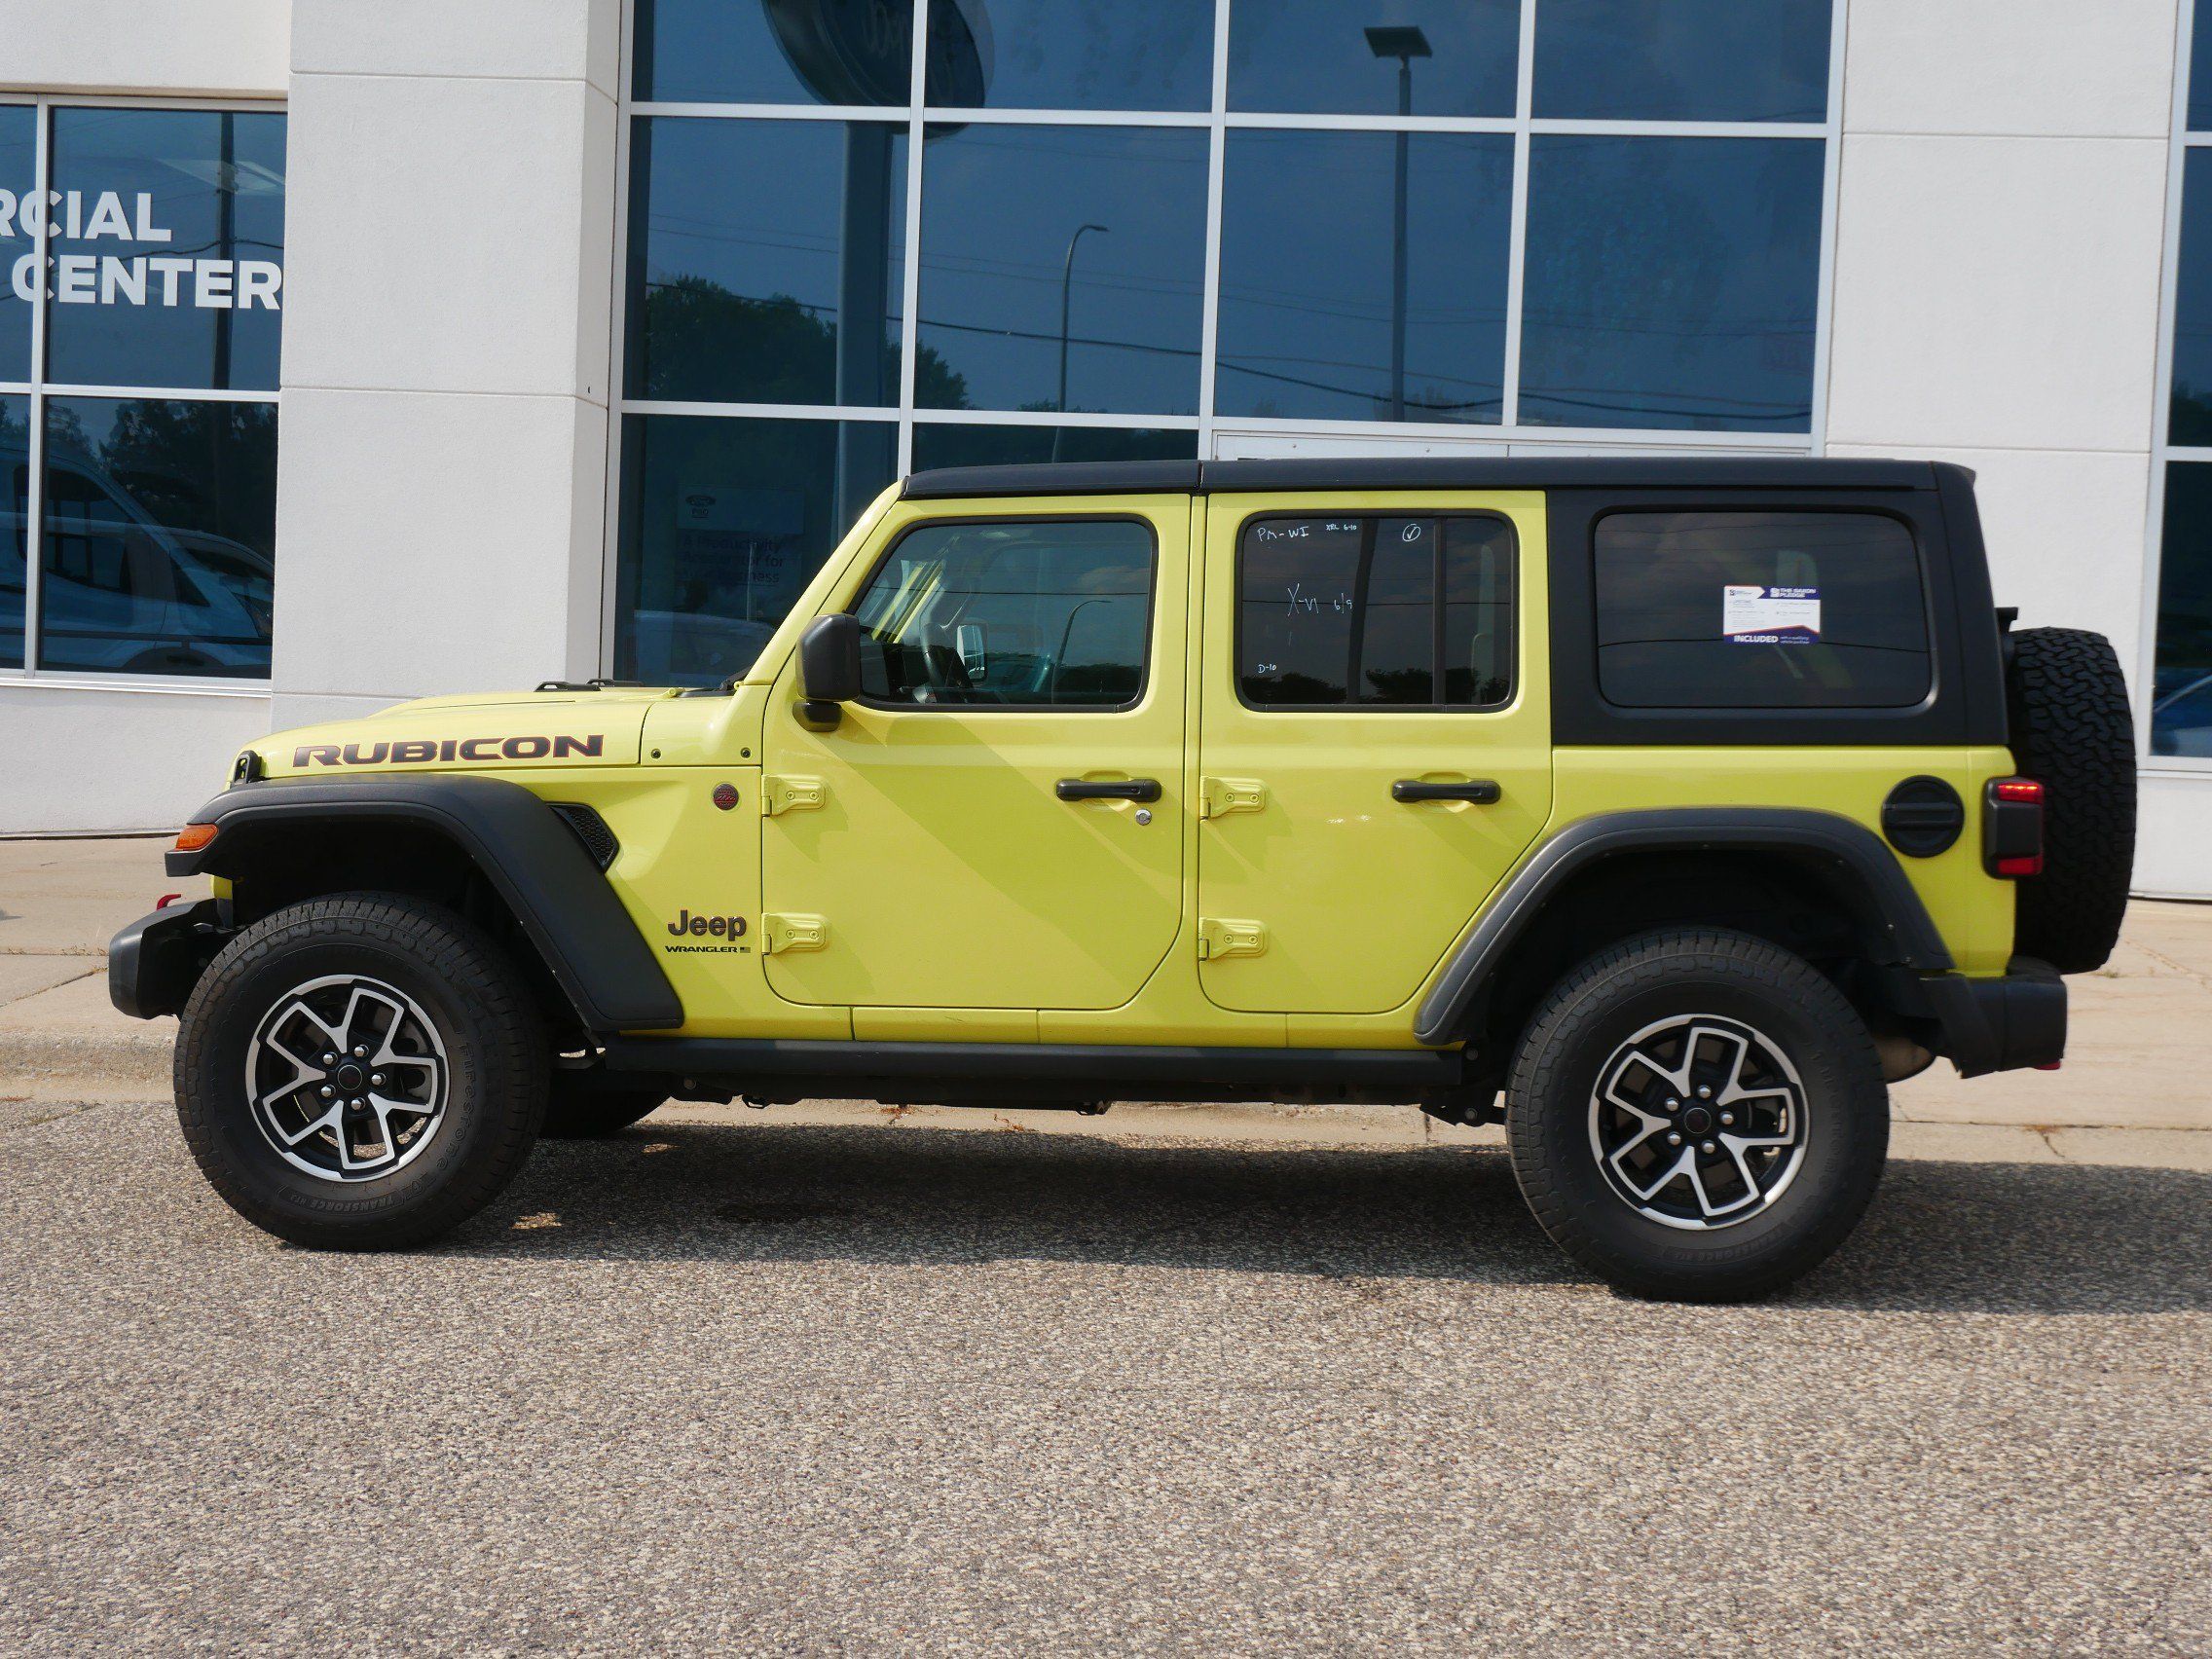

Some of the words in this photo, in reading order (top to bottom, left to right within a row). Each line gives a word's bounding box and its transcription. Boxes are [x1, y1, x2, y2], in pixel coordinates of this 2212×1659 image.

[12, 252, 282, 310] CENTER
[292, 734, 605, 768] RUBICON
[667, 909, 747, 941] Jeep
